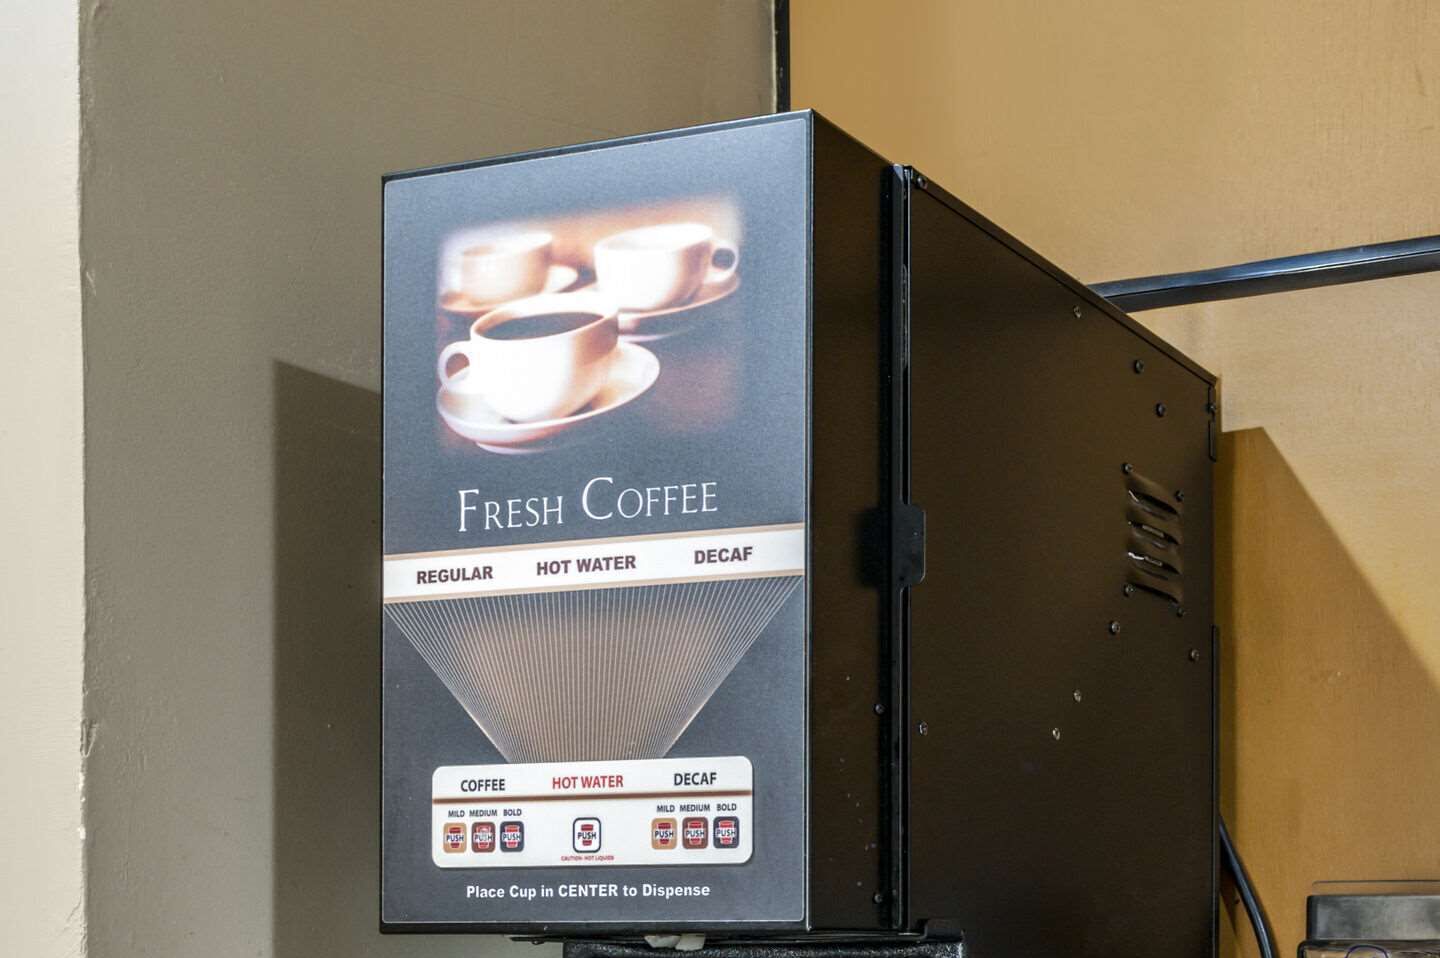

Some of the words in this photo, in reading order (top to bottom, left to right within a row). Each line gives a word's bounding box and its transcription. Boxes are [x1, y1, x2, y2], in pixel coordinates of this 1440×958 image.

[458, 488, 564, 533] FRESH
[582, 476, 718, 520] COFFEE
[694, 546, 754, 566] DECAF
[536, 559, 572, 577] HOT
[576, 555, 637, 574] WATER
[416, 565, 494, 586] REGULAR
[552, 776, 579, 790] HOT
[581, 774, 624, 789] WATER
[673, 771, 718, 786] DECAF
[460, 778, 506, 793] COFFEE
[448, 810, 465, 818] MILD
[469, 809, 498, 818] MEDIUM
[503, 808, 522, 817] BOLD
[656, 804, 676, 813] MILD
[680, 803, 711, 812] MEDIUM
[716, 803, 737, 812] BOLD
[446, 834, 464, 842] PUSH
[474, 834, 493, 842] PUSH
[503, 833, 520, 841] PUSH
[577, 830, 597, 841] PUSH
[655, 830, 674, 838] PUSH
[685, 829, 704, 837] PUSH
[716, 829, 735, 837] PUSH
[466, 885, 506, 900] Place
[509, 885, 537, 901] Cup
[540, 884, 554, 898] in
[558, 884, 618, 898] CENTER
[622, 884, 639, 897] to
[642, 884, 711, 900] Dispense
